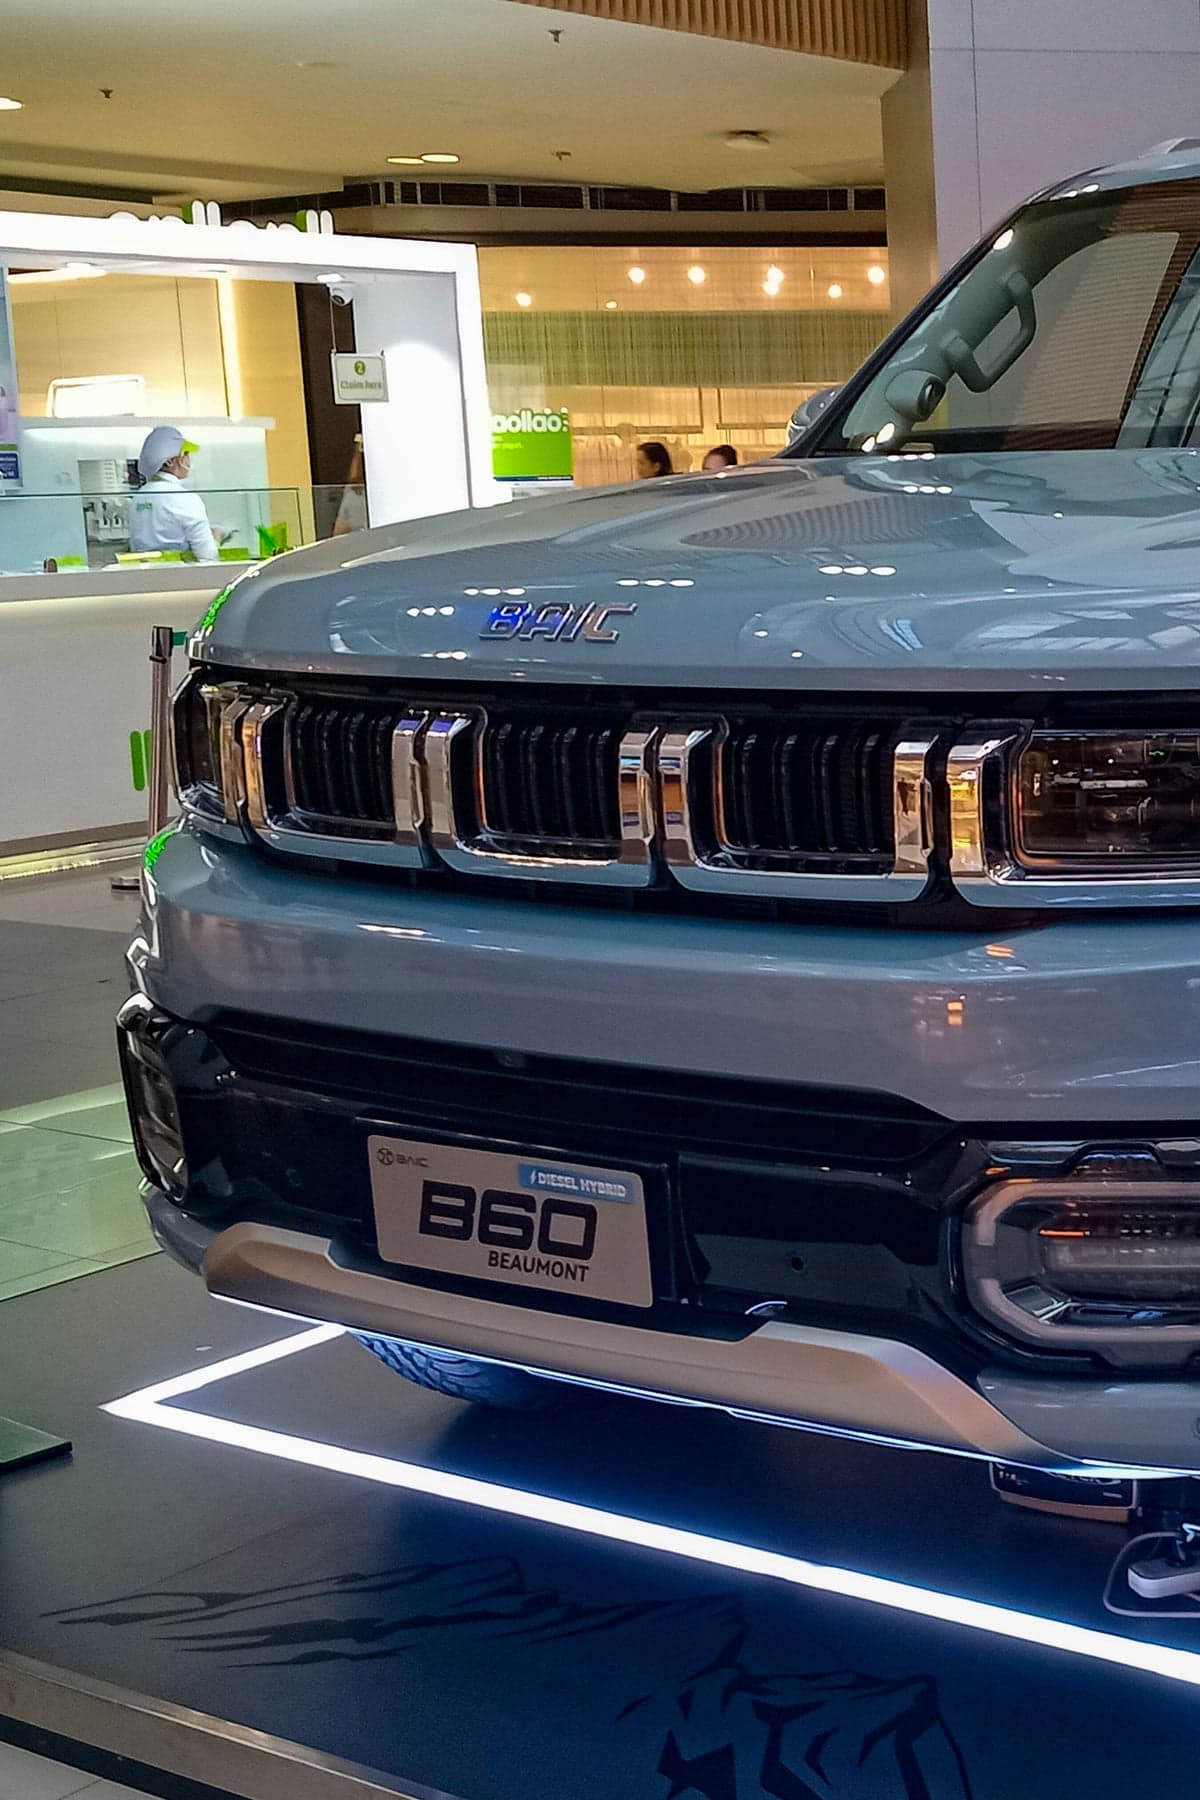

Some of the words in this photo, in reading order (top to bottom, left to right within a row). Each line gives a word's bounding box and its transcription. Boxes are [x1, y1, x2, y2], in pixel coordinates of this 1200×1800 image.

[479, 600, 637, 643] BAIC
[396, 1153, 429, 1168] BAIC
[537, 1171, 579, 1191] DIESEL
[579, 1178, 626, 1198] HYBRID
[419, 1180, 598, 1260] B60
[487, 1250, 590, 1282] BEAUMONT
